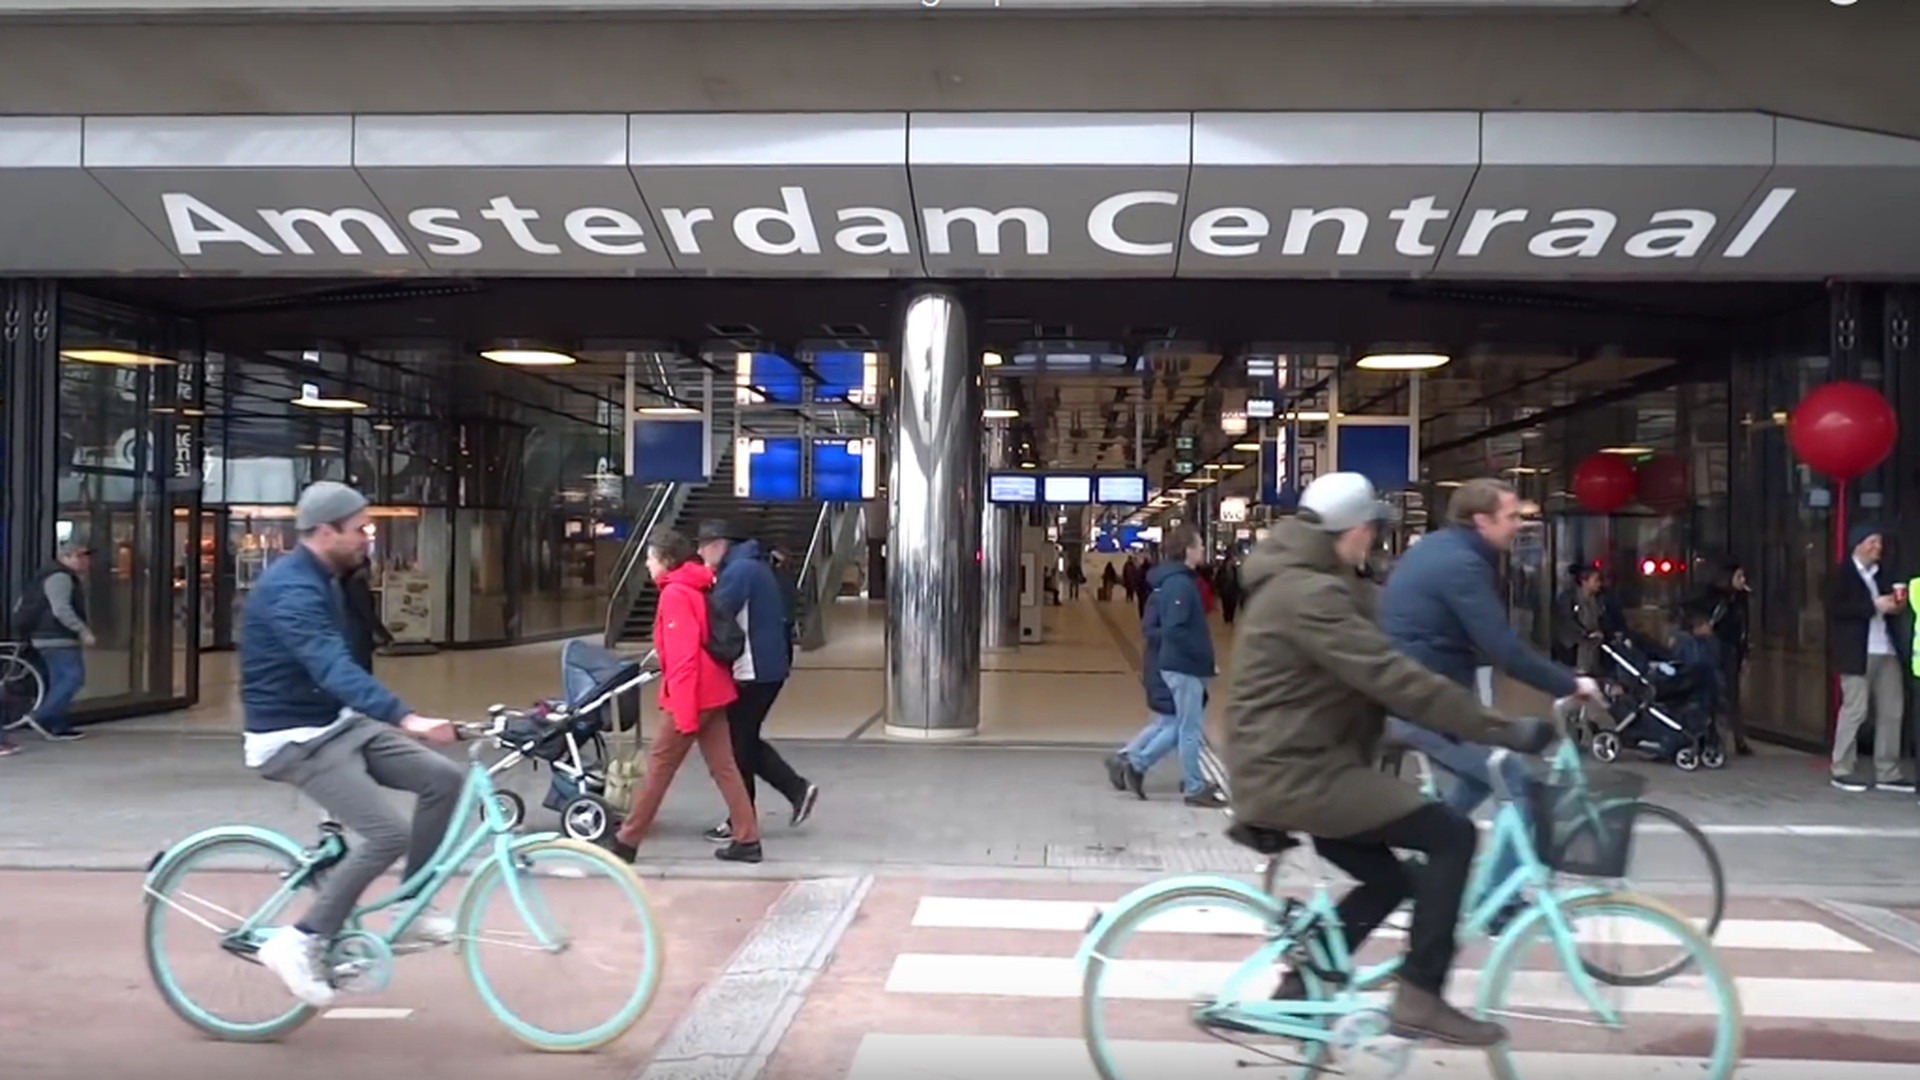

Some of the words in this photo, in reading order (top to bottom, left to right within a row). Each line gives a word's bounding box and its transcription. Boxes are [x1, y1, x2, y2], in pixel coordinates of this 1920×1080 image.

[160, 186, 1050, 256] Amsterdam
[1087, 187, 1796, 258] Centraal
[1223, 510, 1242, 520] WC
